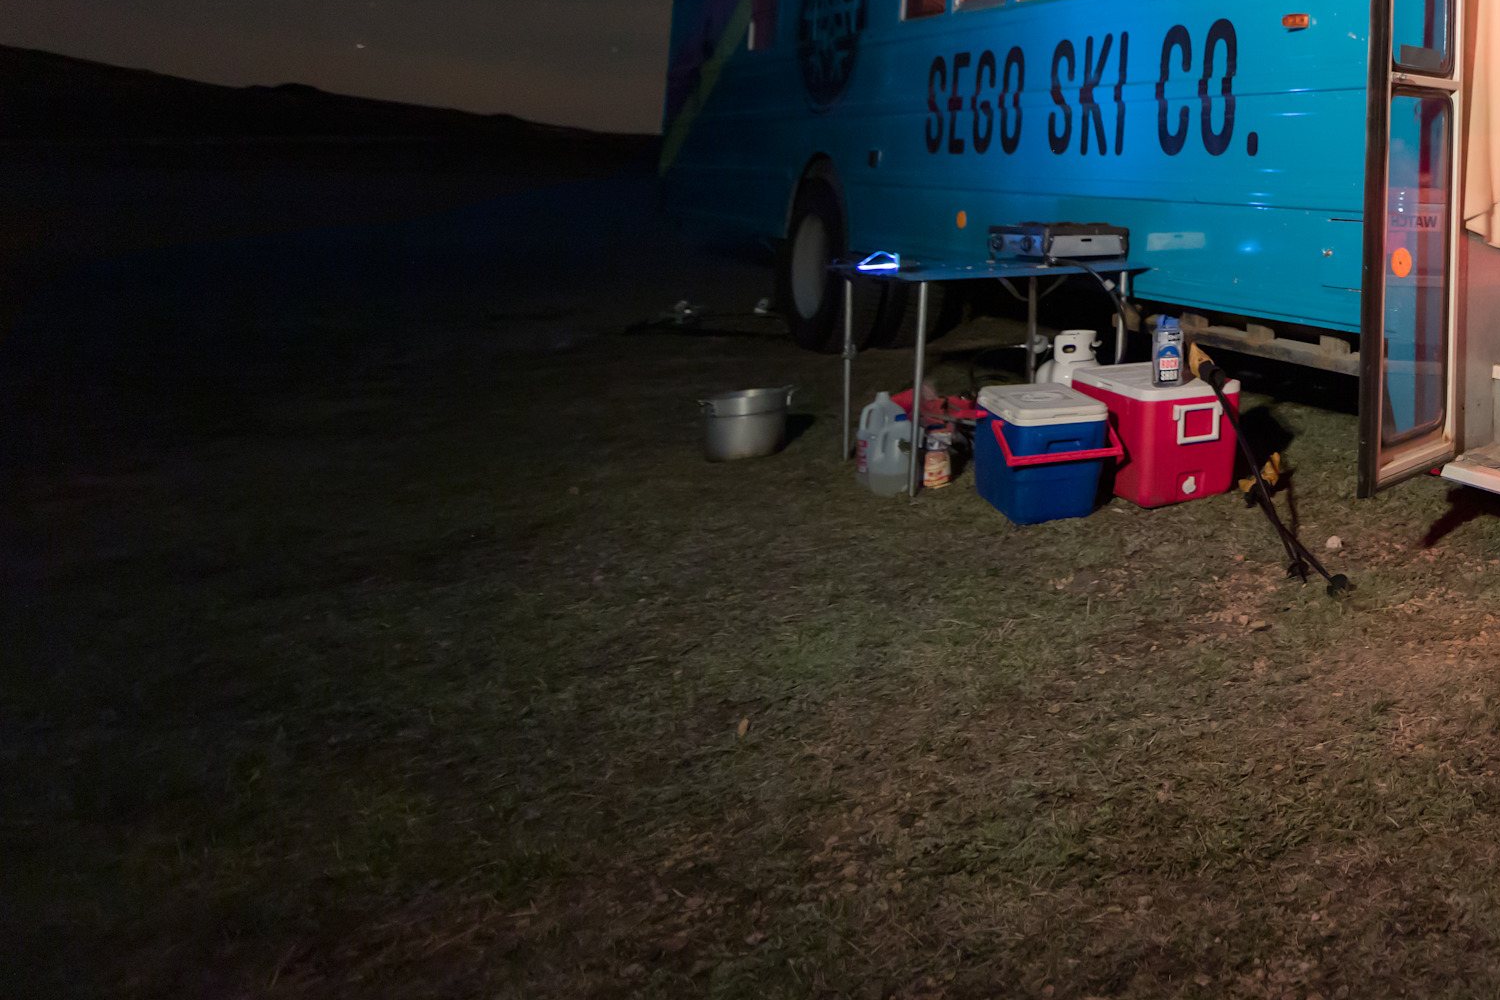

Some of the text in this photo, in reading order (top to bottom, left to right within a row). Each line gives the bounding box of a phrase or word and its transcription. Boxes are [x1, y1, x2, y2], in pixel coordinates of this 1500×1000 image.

[925, 18, 1259, 156] SEGO SKI CO.
[1160, 359, 1178, 369] ROCK
